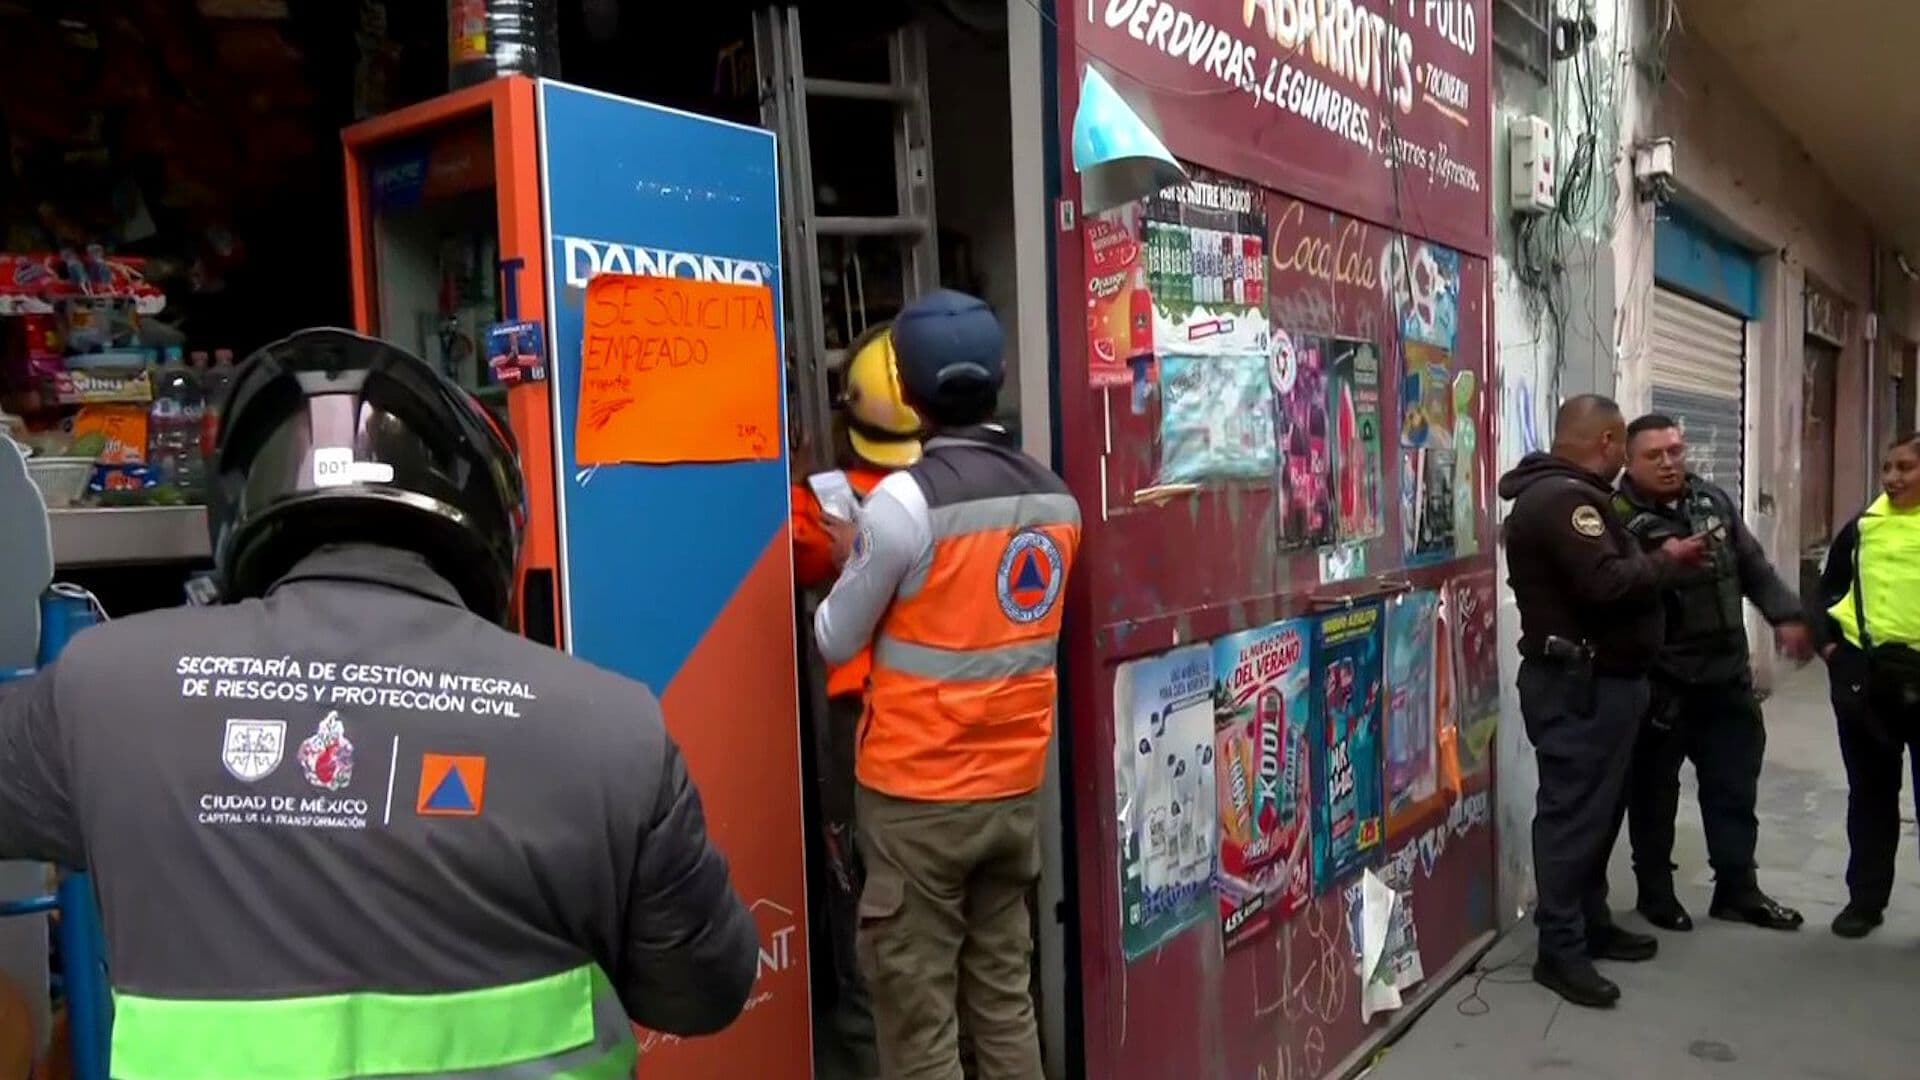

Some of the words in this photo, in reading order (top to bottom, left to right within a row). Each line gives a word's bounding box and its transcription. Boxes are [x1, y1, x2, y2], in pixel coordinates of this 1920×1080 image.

[1263, 57, 1374, 158] LEGUMBRES,
[1273, 202, 1331, 280] Coca
[1335, 220, 1377, 289] Cola
[591, 279, 641, 329] SE
[647, 288, 768, 330] SOLICITA
[319, 461, 347, 475] DOT
[176, 655, 301, 678] SECRETARÍA
[308, 662, 336, 681] DE
[439, 671, 536, 699] INTEGRAL
[182, 678, 209, 697] DE
[215, 679, 308, 700] RIESGOS
[313, 685, 326, 701] Y
[331, 686, 465, 712] PROTECCIÓN
[471, 697, 520, 718] CIVIL
[199, 813, 241, 824] CAPITAL
[261, 814, 272, 824] LA
[275, 814, 367, 828] TRANSFORMACIÓN
[200, 794, 266, 810] CIUDAD
[271, 796, 295, 811] DE
[300, 796, 368, 815] MÉXICO
